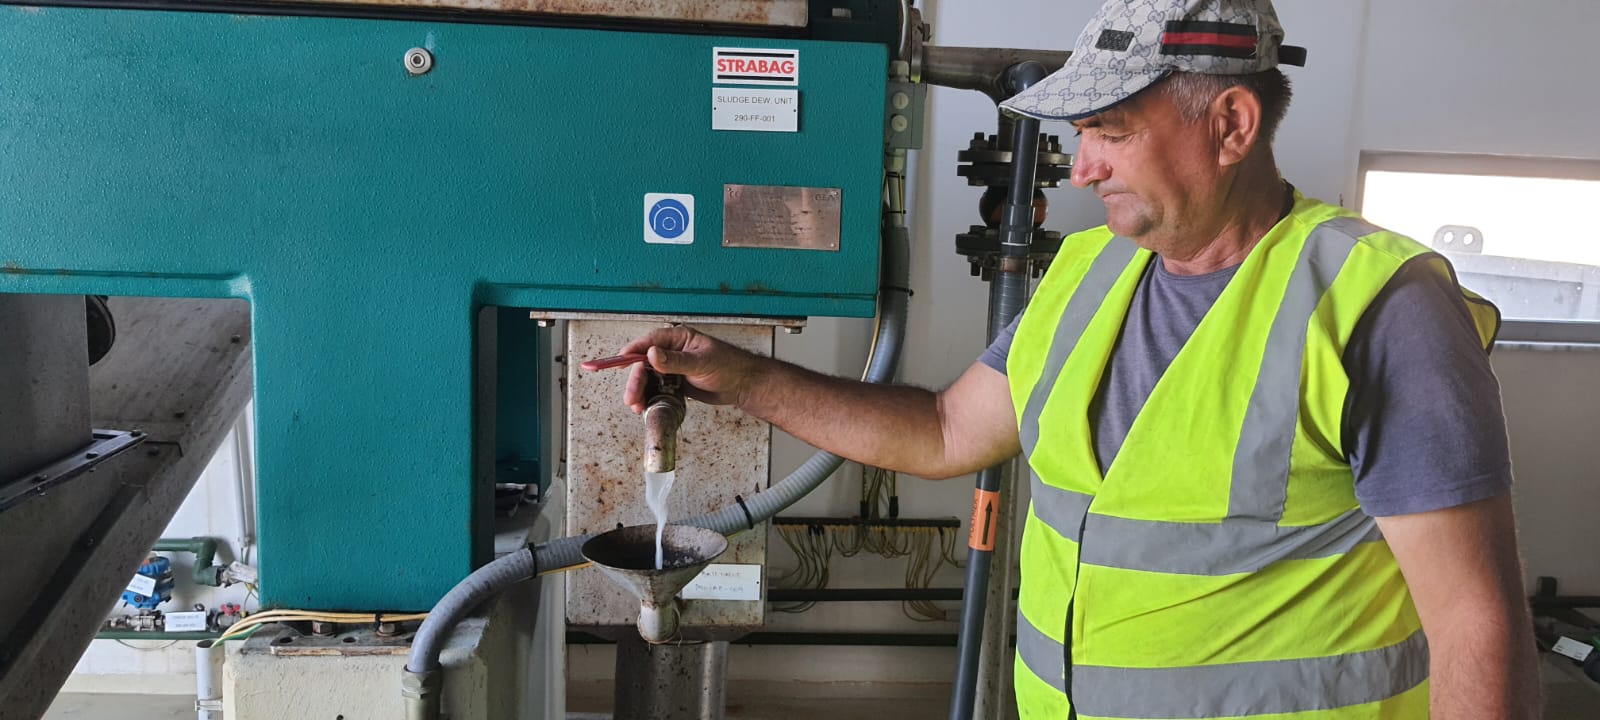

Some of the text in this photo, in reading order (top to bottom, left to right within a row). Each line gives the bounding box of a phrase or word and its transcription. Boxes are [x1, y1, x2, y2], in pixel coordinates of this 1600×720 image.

[717, 59, 795, 74] STRABAG
[717, 96, 750, 104] SLUDGE
[751, 97, 772, 105] DEW.
[734, 114, 776, 122] 290-FF-001
